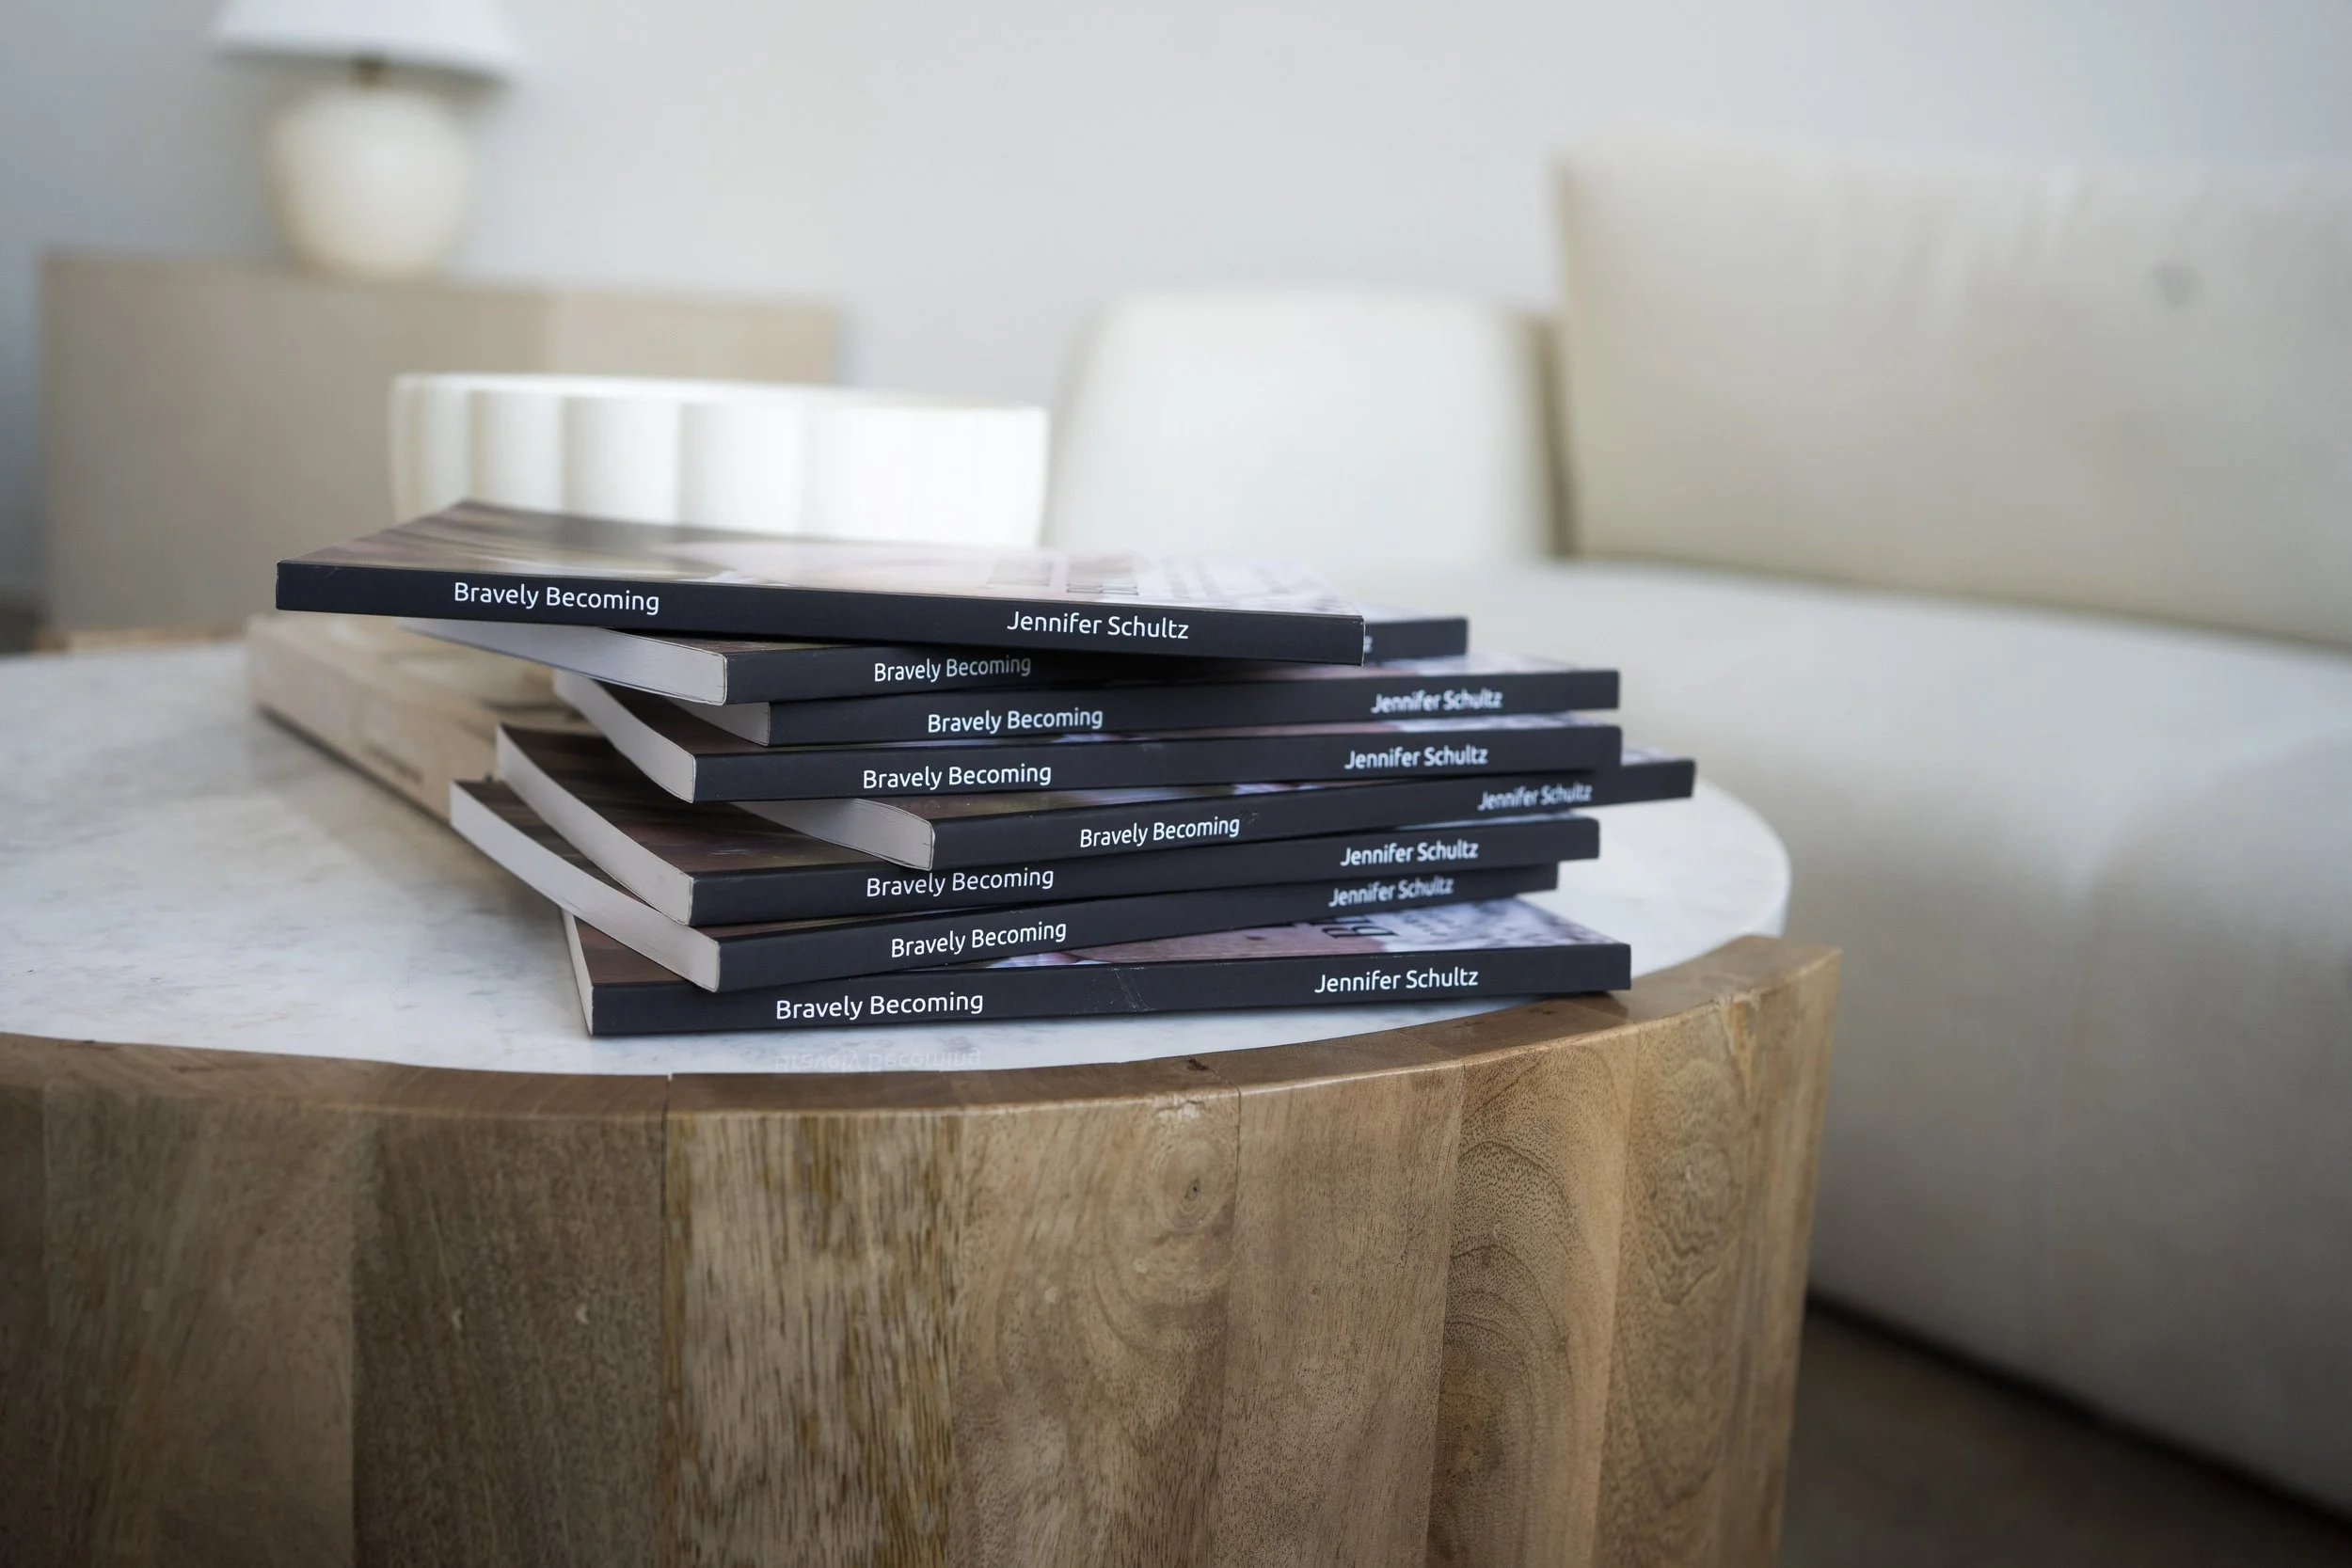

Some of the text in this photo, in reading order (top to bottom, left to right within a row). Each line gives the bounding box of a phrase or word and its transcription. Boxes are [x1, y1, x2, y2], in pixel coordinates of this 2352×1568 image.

[453, 581, 660, 616] Bravely Becoming
[1007, 610, 1189, 640] Jennifer Schultz
[874, 657, 1031, 683] Bravely Becoming
[1370, 688, 1503, 714] Jennifer Schultz
[928, 706, 1104, 735] Bravely Becoming
[1343, 744, 1488, 770] Jennifer Schultz
[863, 762, 1052, 791] Bravely Becoming
[1477, 783, 1593, 811] Jennifer Schultz
[1079, 816, 1240, 848] Bravely Becoming
[1339, 839, 1479, 867] Jennifer Schultz
[866, 866, 1055, 897] Bravely Becoming
[1327, 878, 1454, 908] Jennifer Schultz
[891, 921, 1067, 958] Bravely Becoming
[1313, 966, 1479, 994] Jennifer Schultz
[776, 990, 983, 1022] Bravely Becoming
